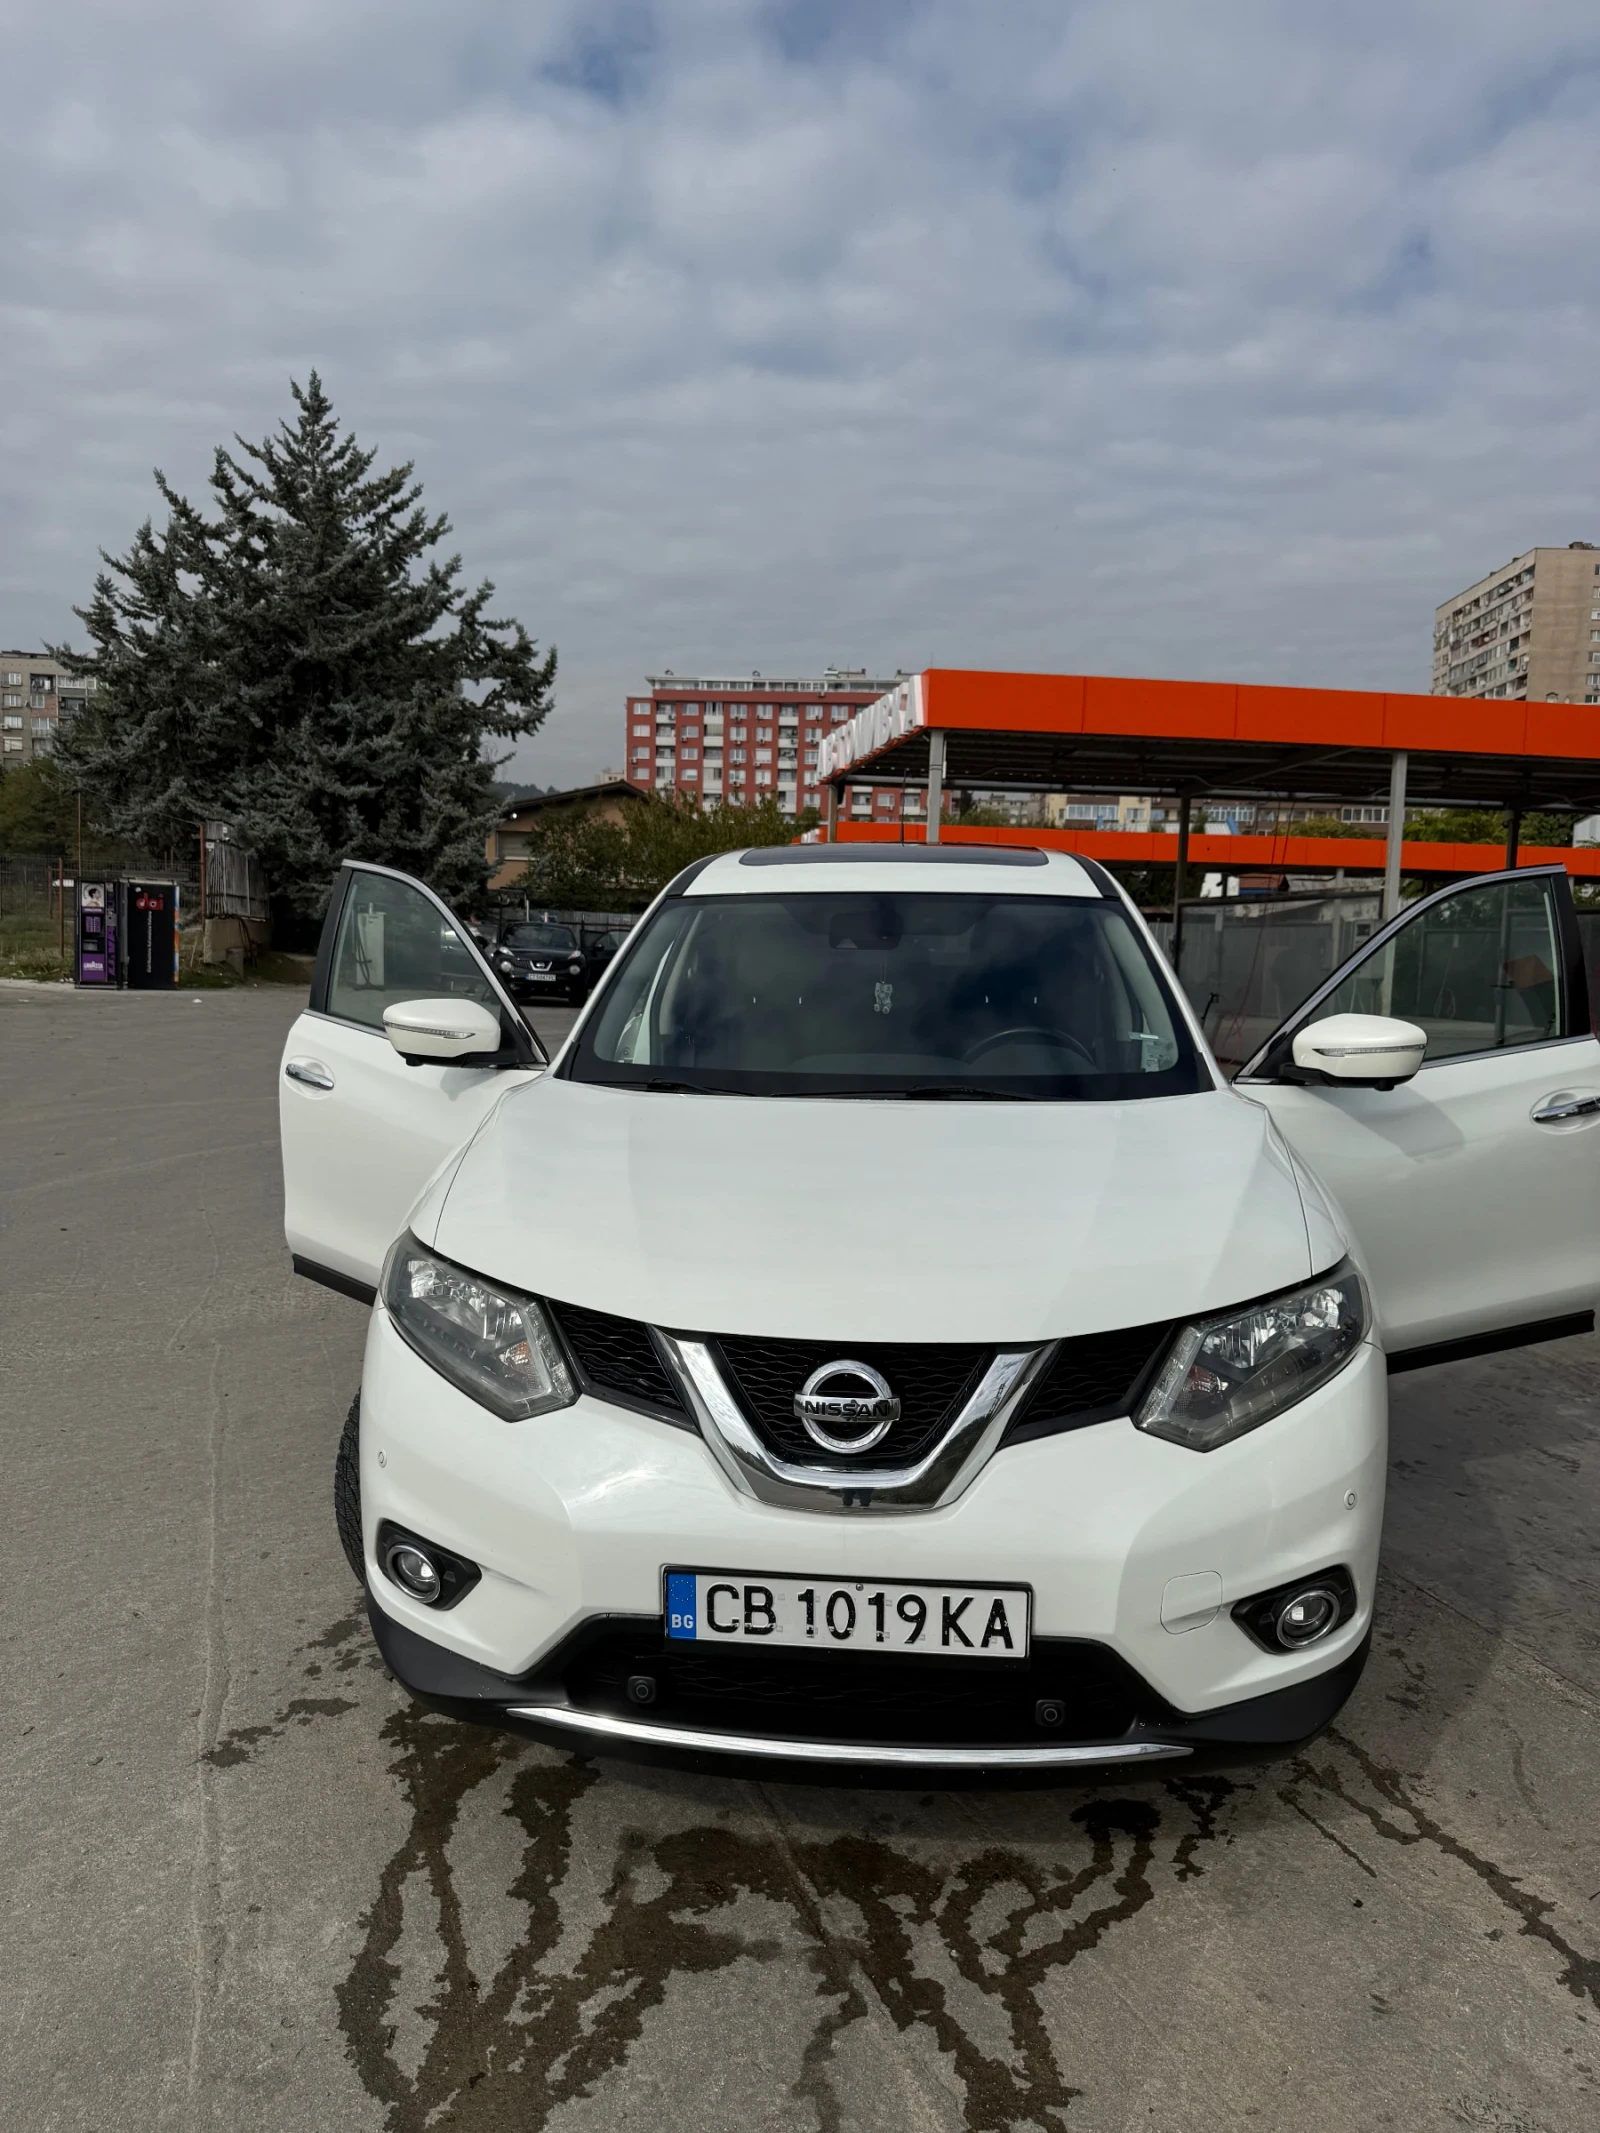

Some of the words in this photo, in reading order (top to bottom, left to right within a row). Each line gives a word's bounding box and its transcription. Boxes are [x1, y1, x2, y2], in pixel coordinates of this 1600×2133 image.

[804, 1400, 890, 1418] NISSAN
[671, 1613, 694, 1629] BG
[706, 1582, 777, 1636] CB
[797, 1587, 928, 1645] 1019
[941, 1595, 1015, 1650] KA
